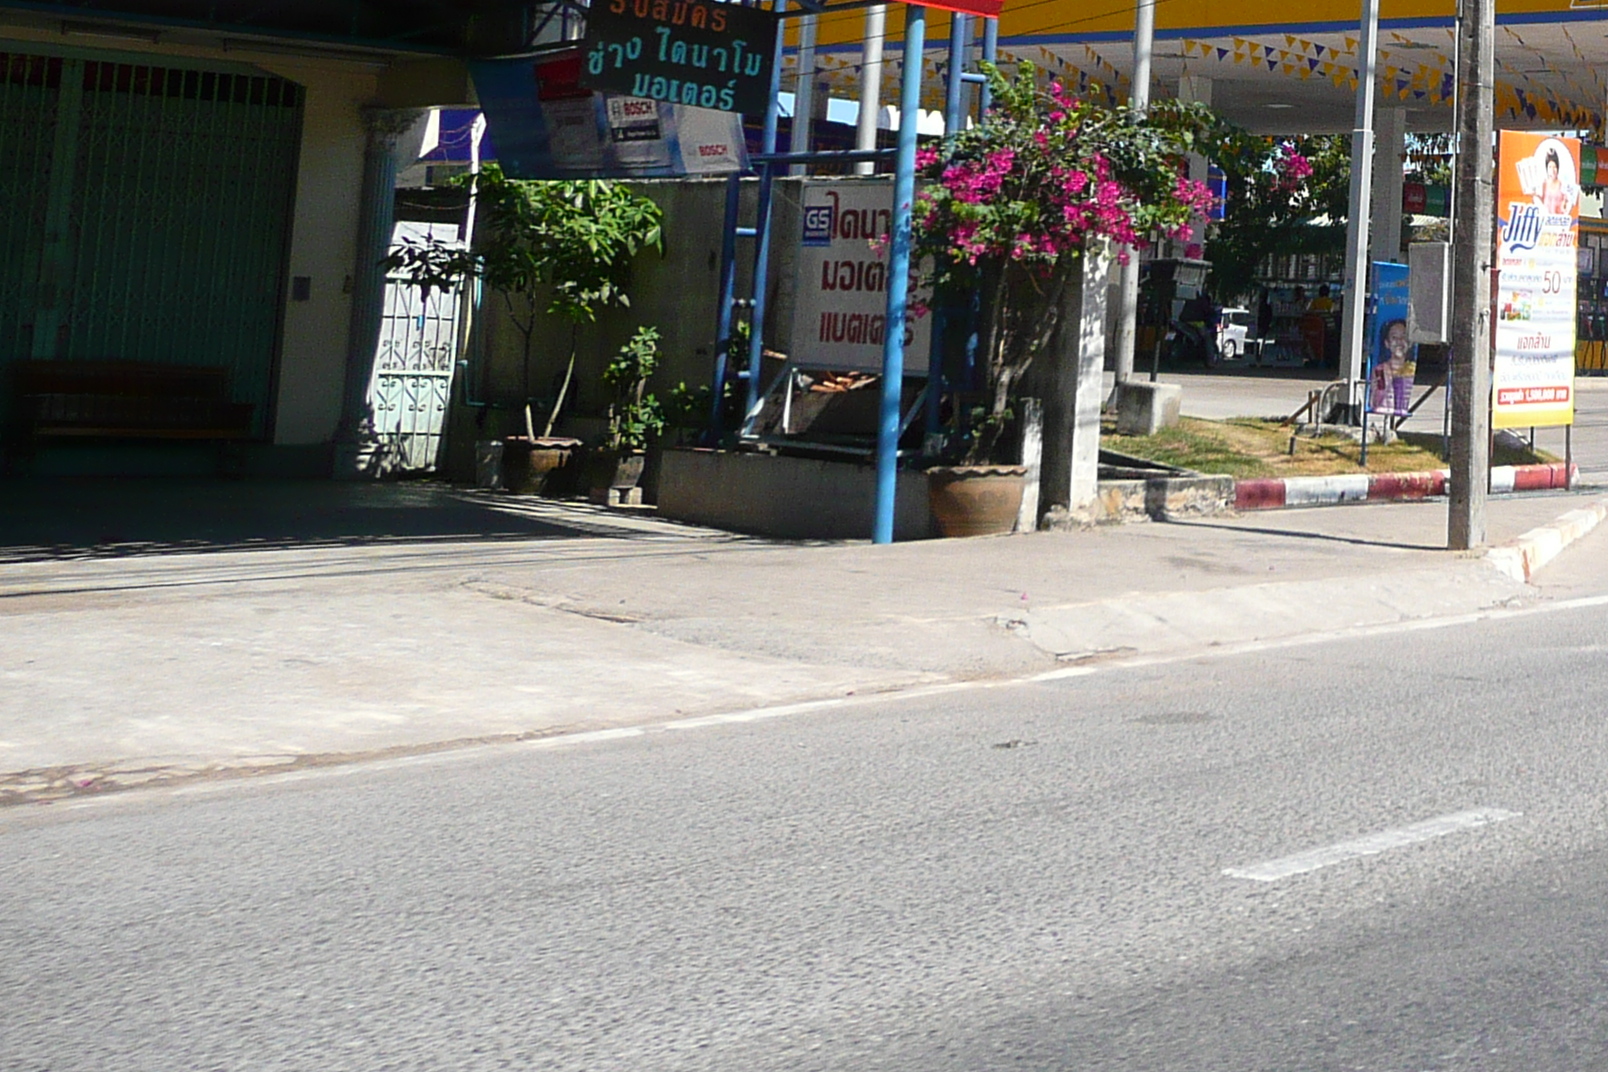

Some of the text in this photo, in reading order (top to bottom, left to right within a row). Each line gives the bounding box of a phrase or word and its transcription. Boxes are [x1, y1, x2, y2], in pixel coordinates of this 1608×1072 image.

[588, 26, 762, 76] ช่าง ไดนาโม
[632, 72, 737, 111] มอเตอร์
[623, 100, 653, 116] BOSCH
[699, 144, 728, 157] BOSCH
[806, 209, 830, 229] GS
[1503, 204, 1545, 254] Jiffy
[1542, 271, 1561, 294] 50
